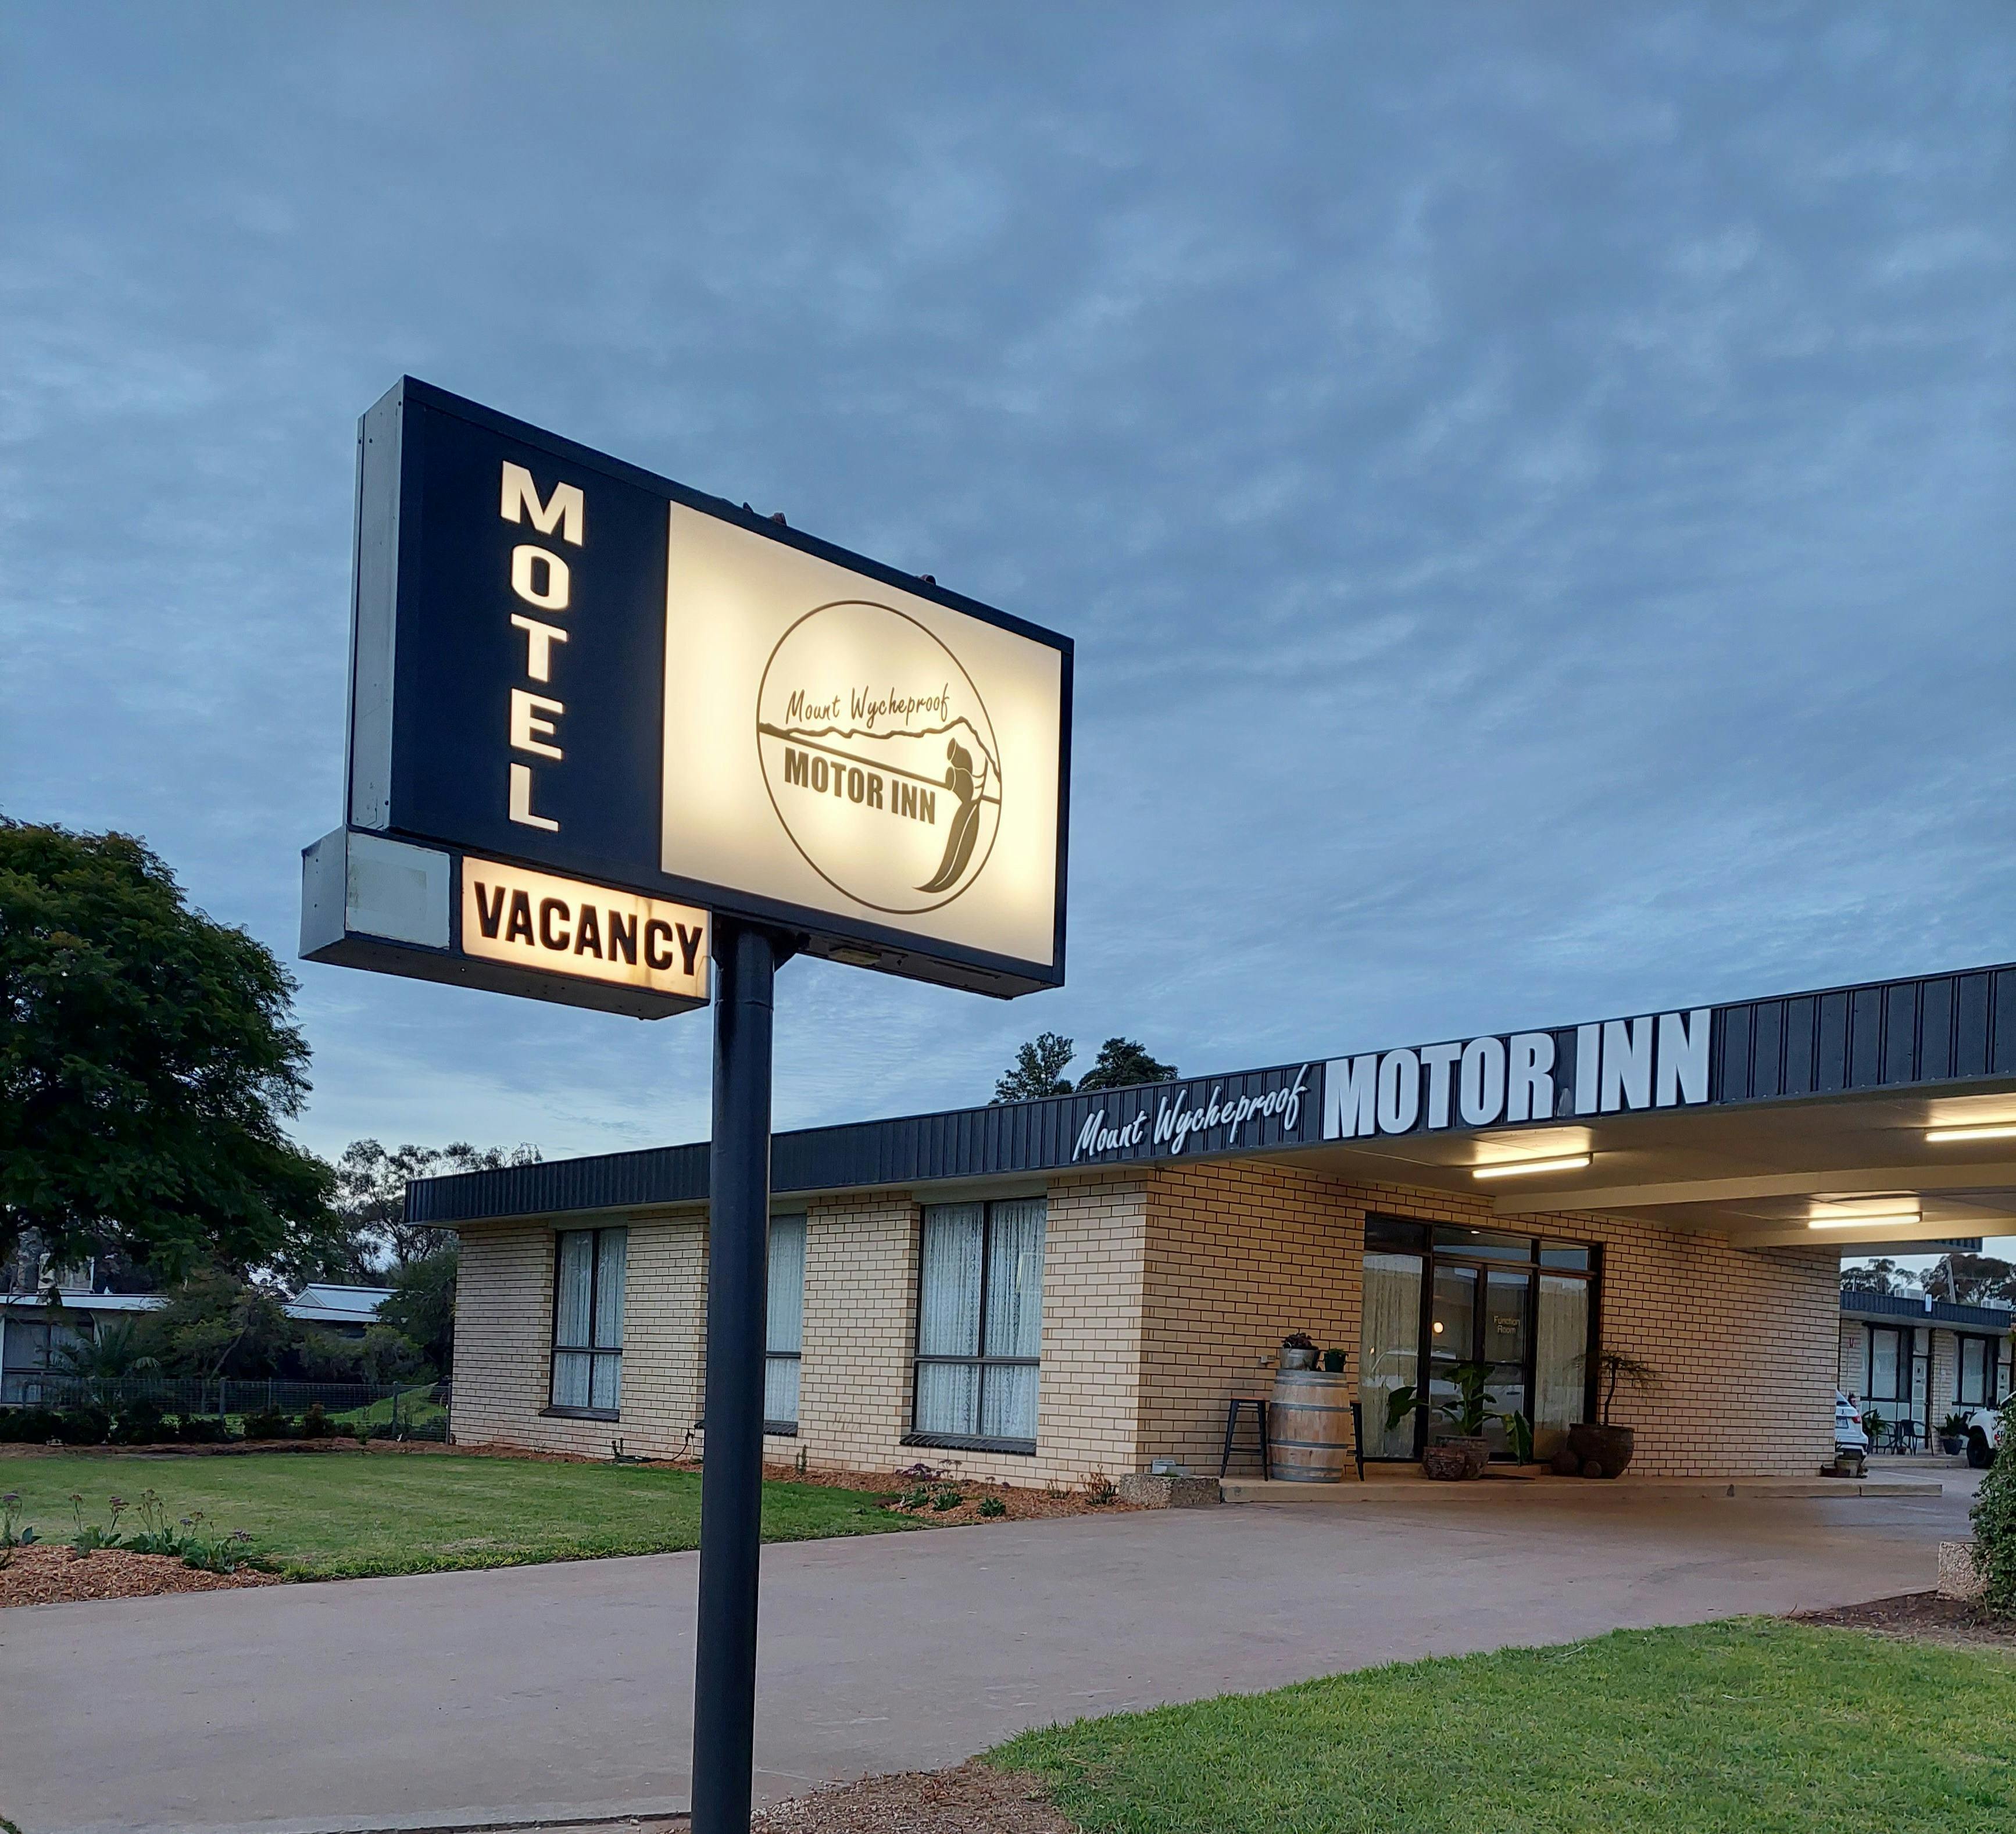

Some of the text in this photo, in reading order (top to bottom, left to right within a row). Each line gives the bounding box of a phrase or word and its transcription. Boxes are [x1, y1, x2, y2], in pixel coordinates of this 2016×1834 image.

[501, 460, 584, 832] MOTEL
[786, 682, 950, 728] Mount Wycheproof
[784, 747, 935, 825] MOTOR INN
[474, 881, 703, 976] VACANCY
[1071, 1009, 1711, 1162] Mount Wycheproof MOTOR INN
